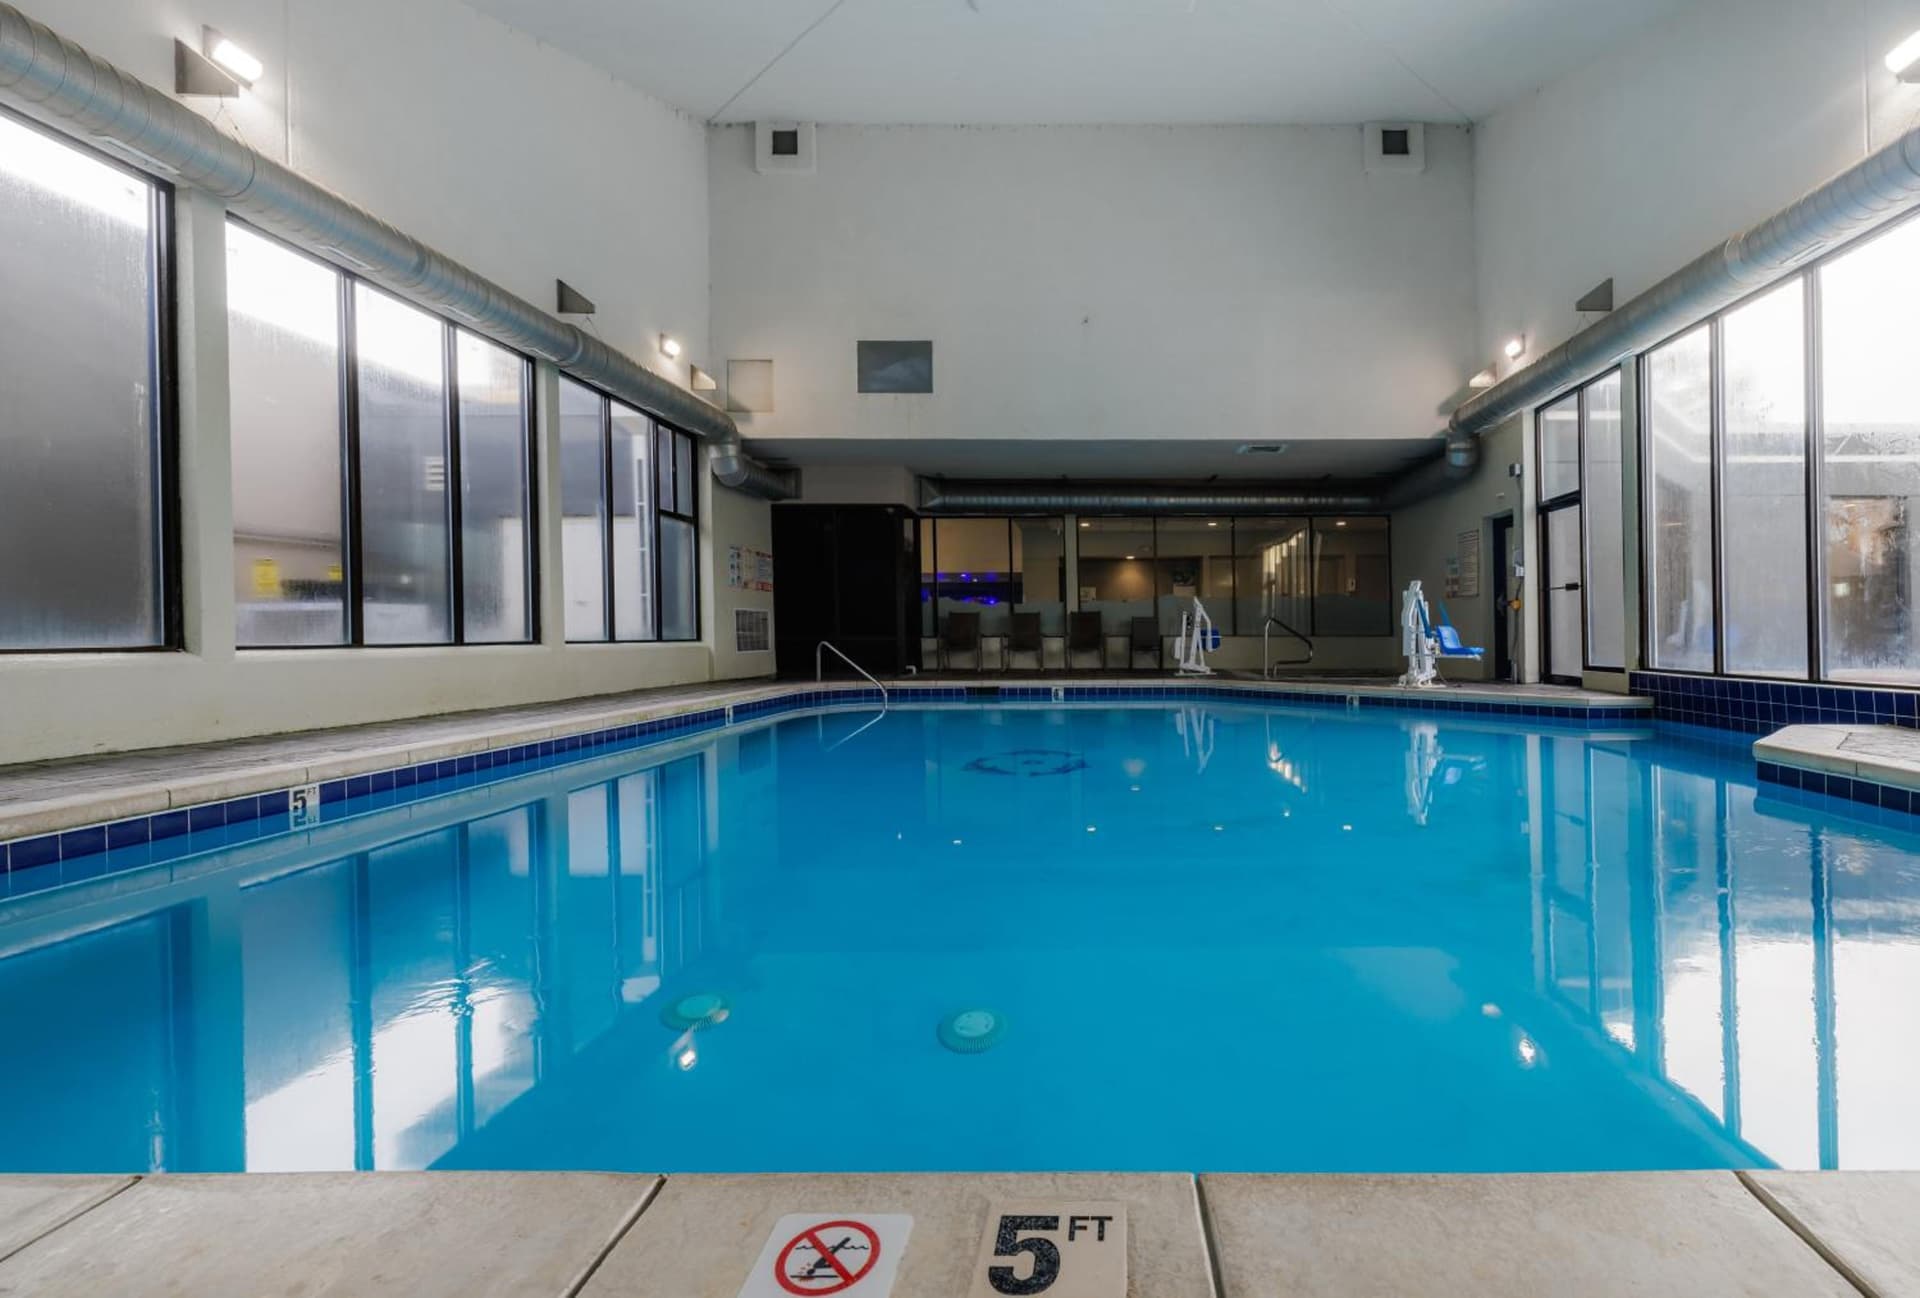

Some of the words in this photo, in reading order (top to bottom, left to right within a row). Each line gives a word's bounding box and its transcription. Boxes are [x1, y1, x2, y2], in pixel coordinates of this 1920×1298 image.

[293, 789, 306, 809] 5
[988, 1215, 1061, 1296] 5
[1067, 1215, 1113, 1242] FT
